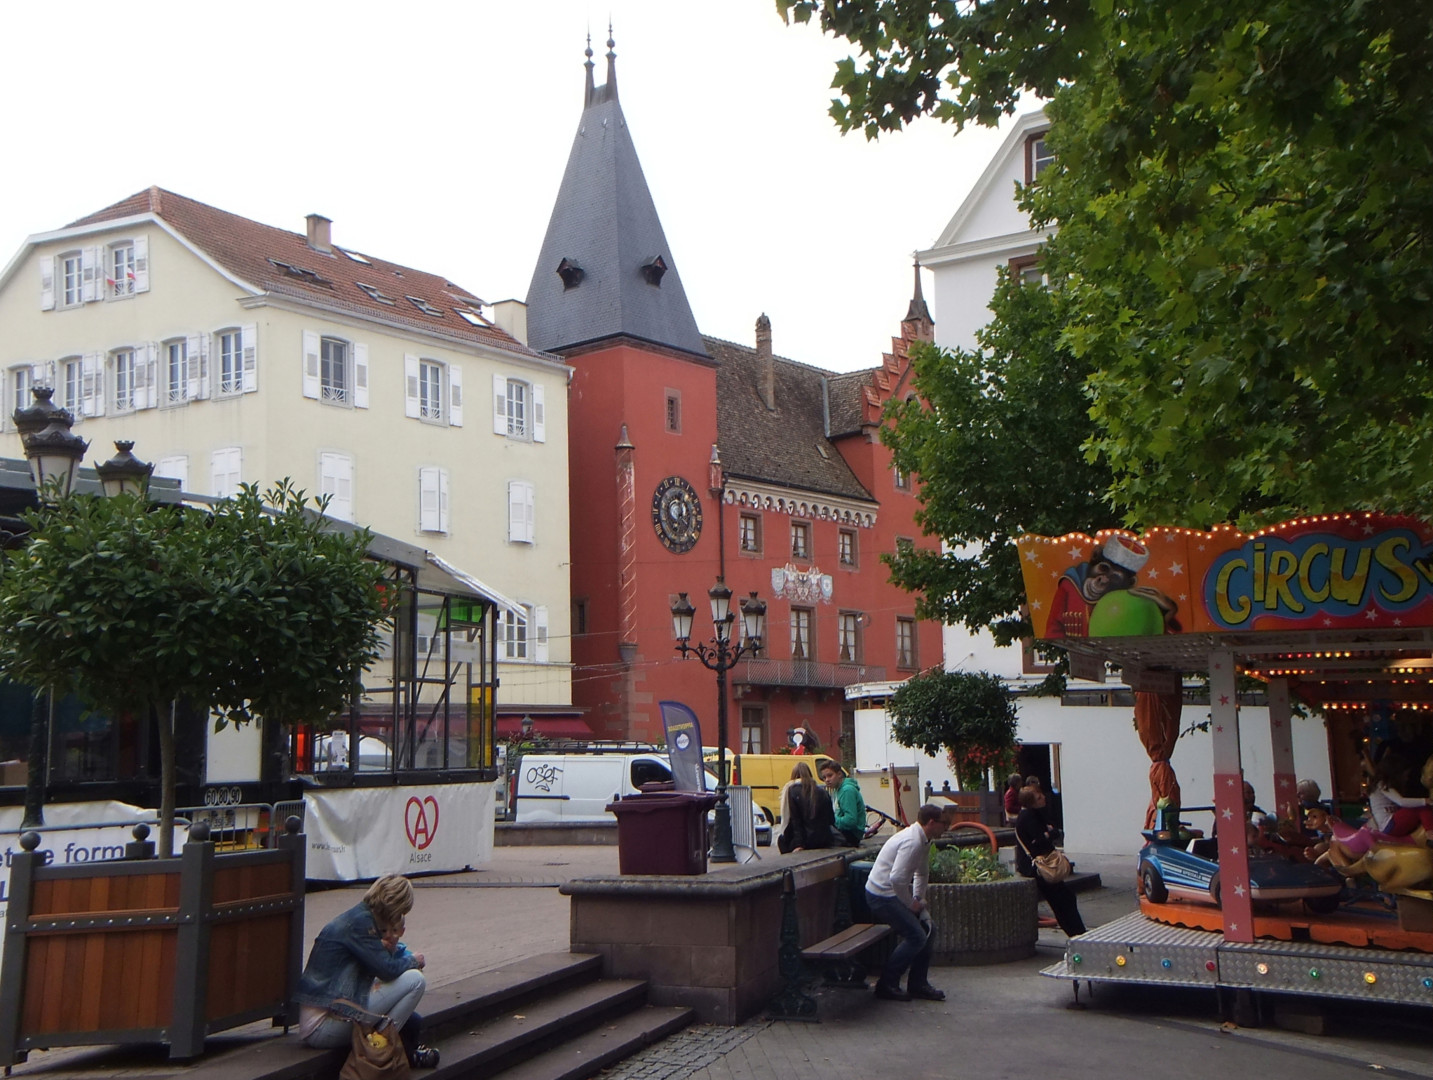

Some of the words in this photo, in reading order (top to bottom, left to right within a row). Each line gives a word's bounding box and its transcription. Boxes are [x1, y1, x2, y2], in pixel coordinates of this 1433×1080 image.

[206, 789, 216, 805] 60
[218, 788, 229, 804] 80
[230, 788, 241, 803] 90
[409, 852, 432, 864] Alsace
